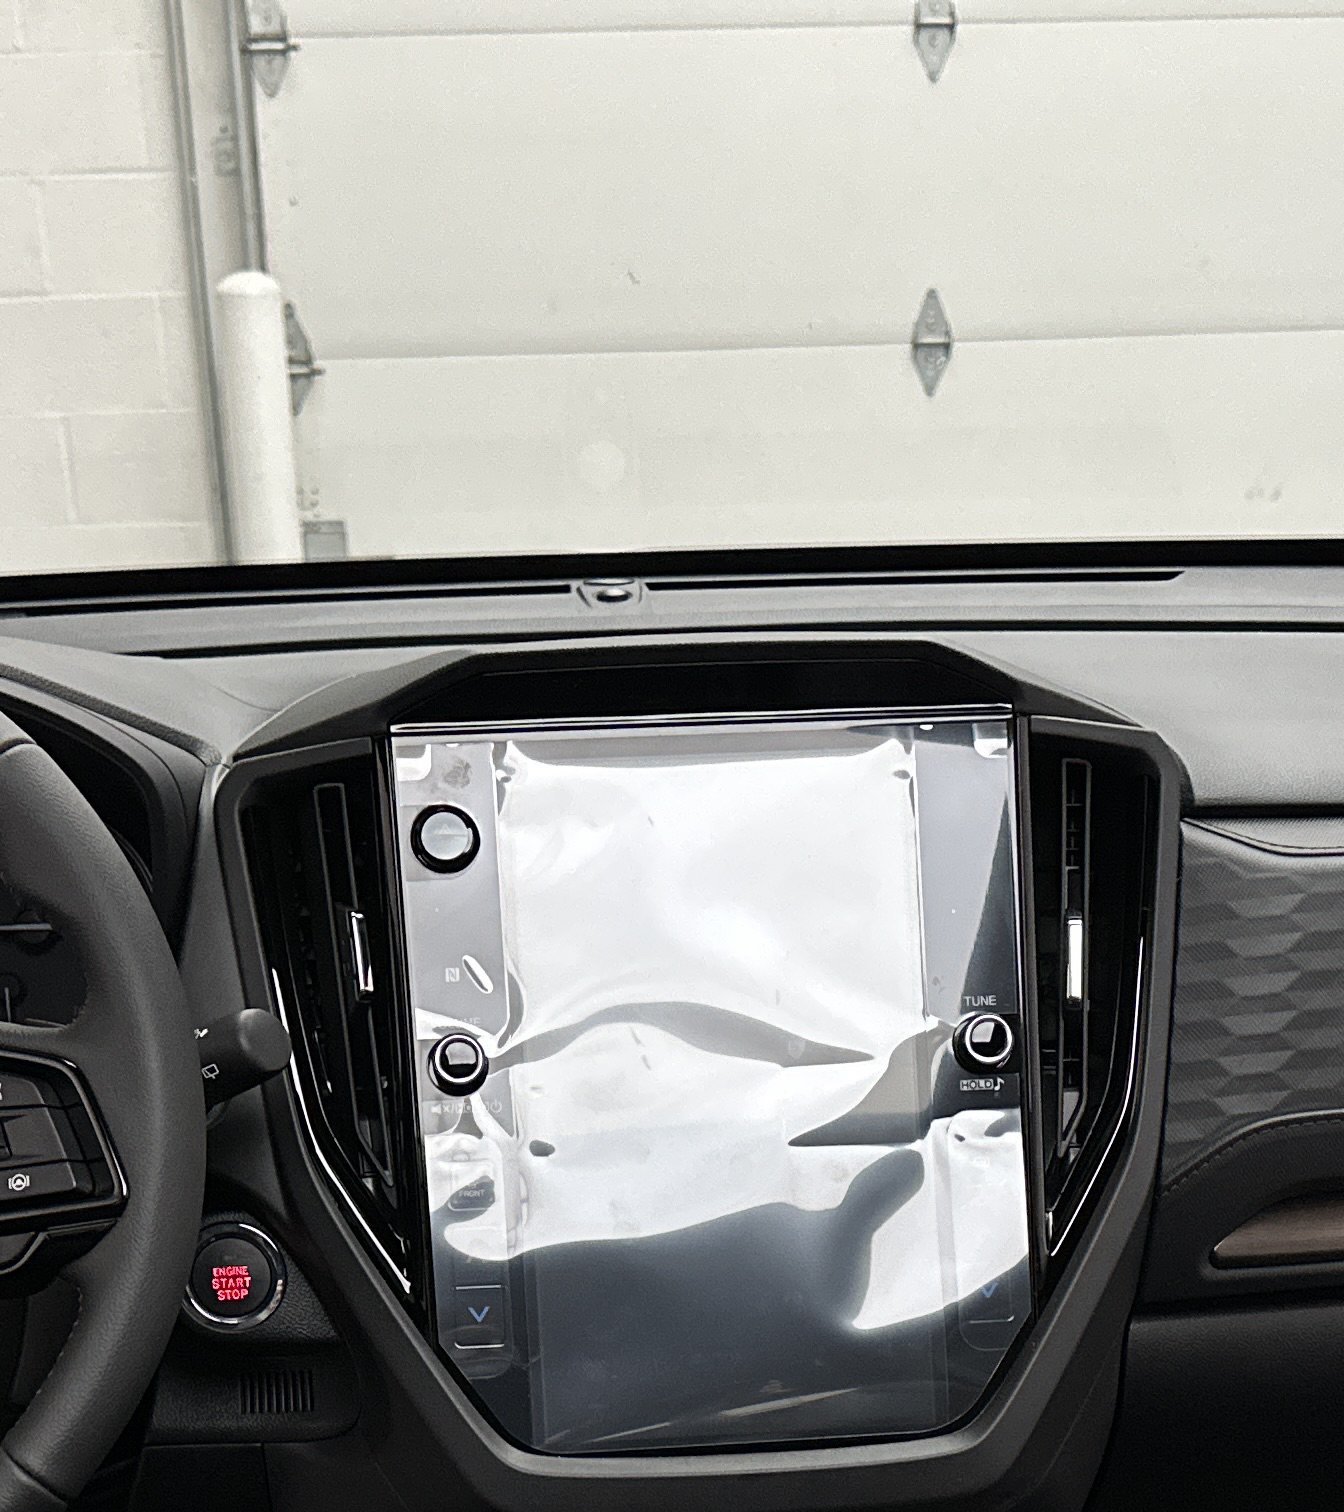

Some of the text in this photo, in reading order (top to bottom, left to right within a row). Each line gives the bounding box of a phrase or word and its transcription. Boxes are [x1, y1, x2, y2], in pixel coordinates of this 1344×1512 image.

[963, 995, 997, 1006] TUNE
[960, 1079, 993, 1090] HOLD
[212, 1265, 249, 1277] ENGINE
[211, 1277, 252, 1289] START
[216, 1289, 249, 1301] STOP
